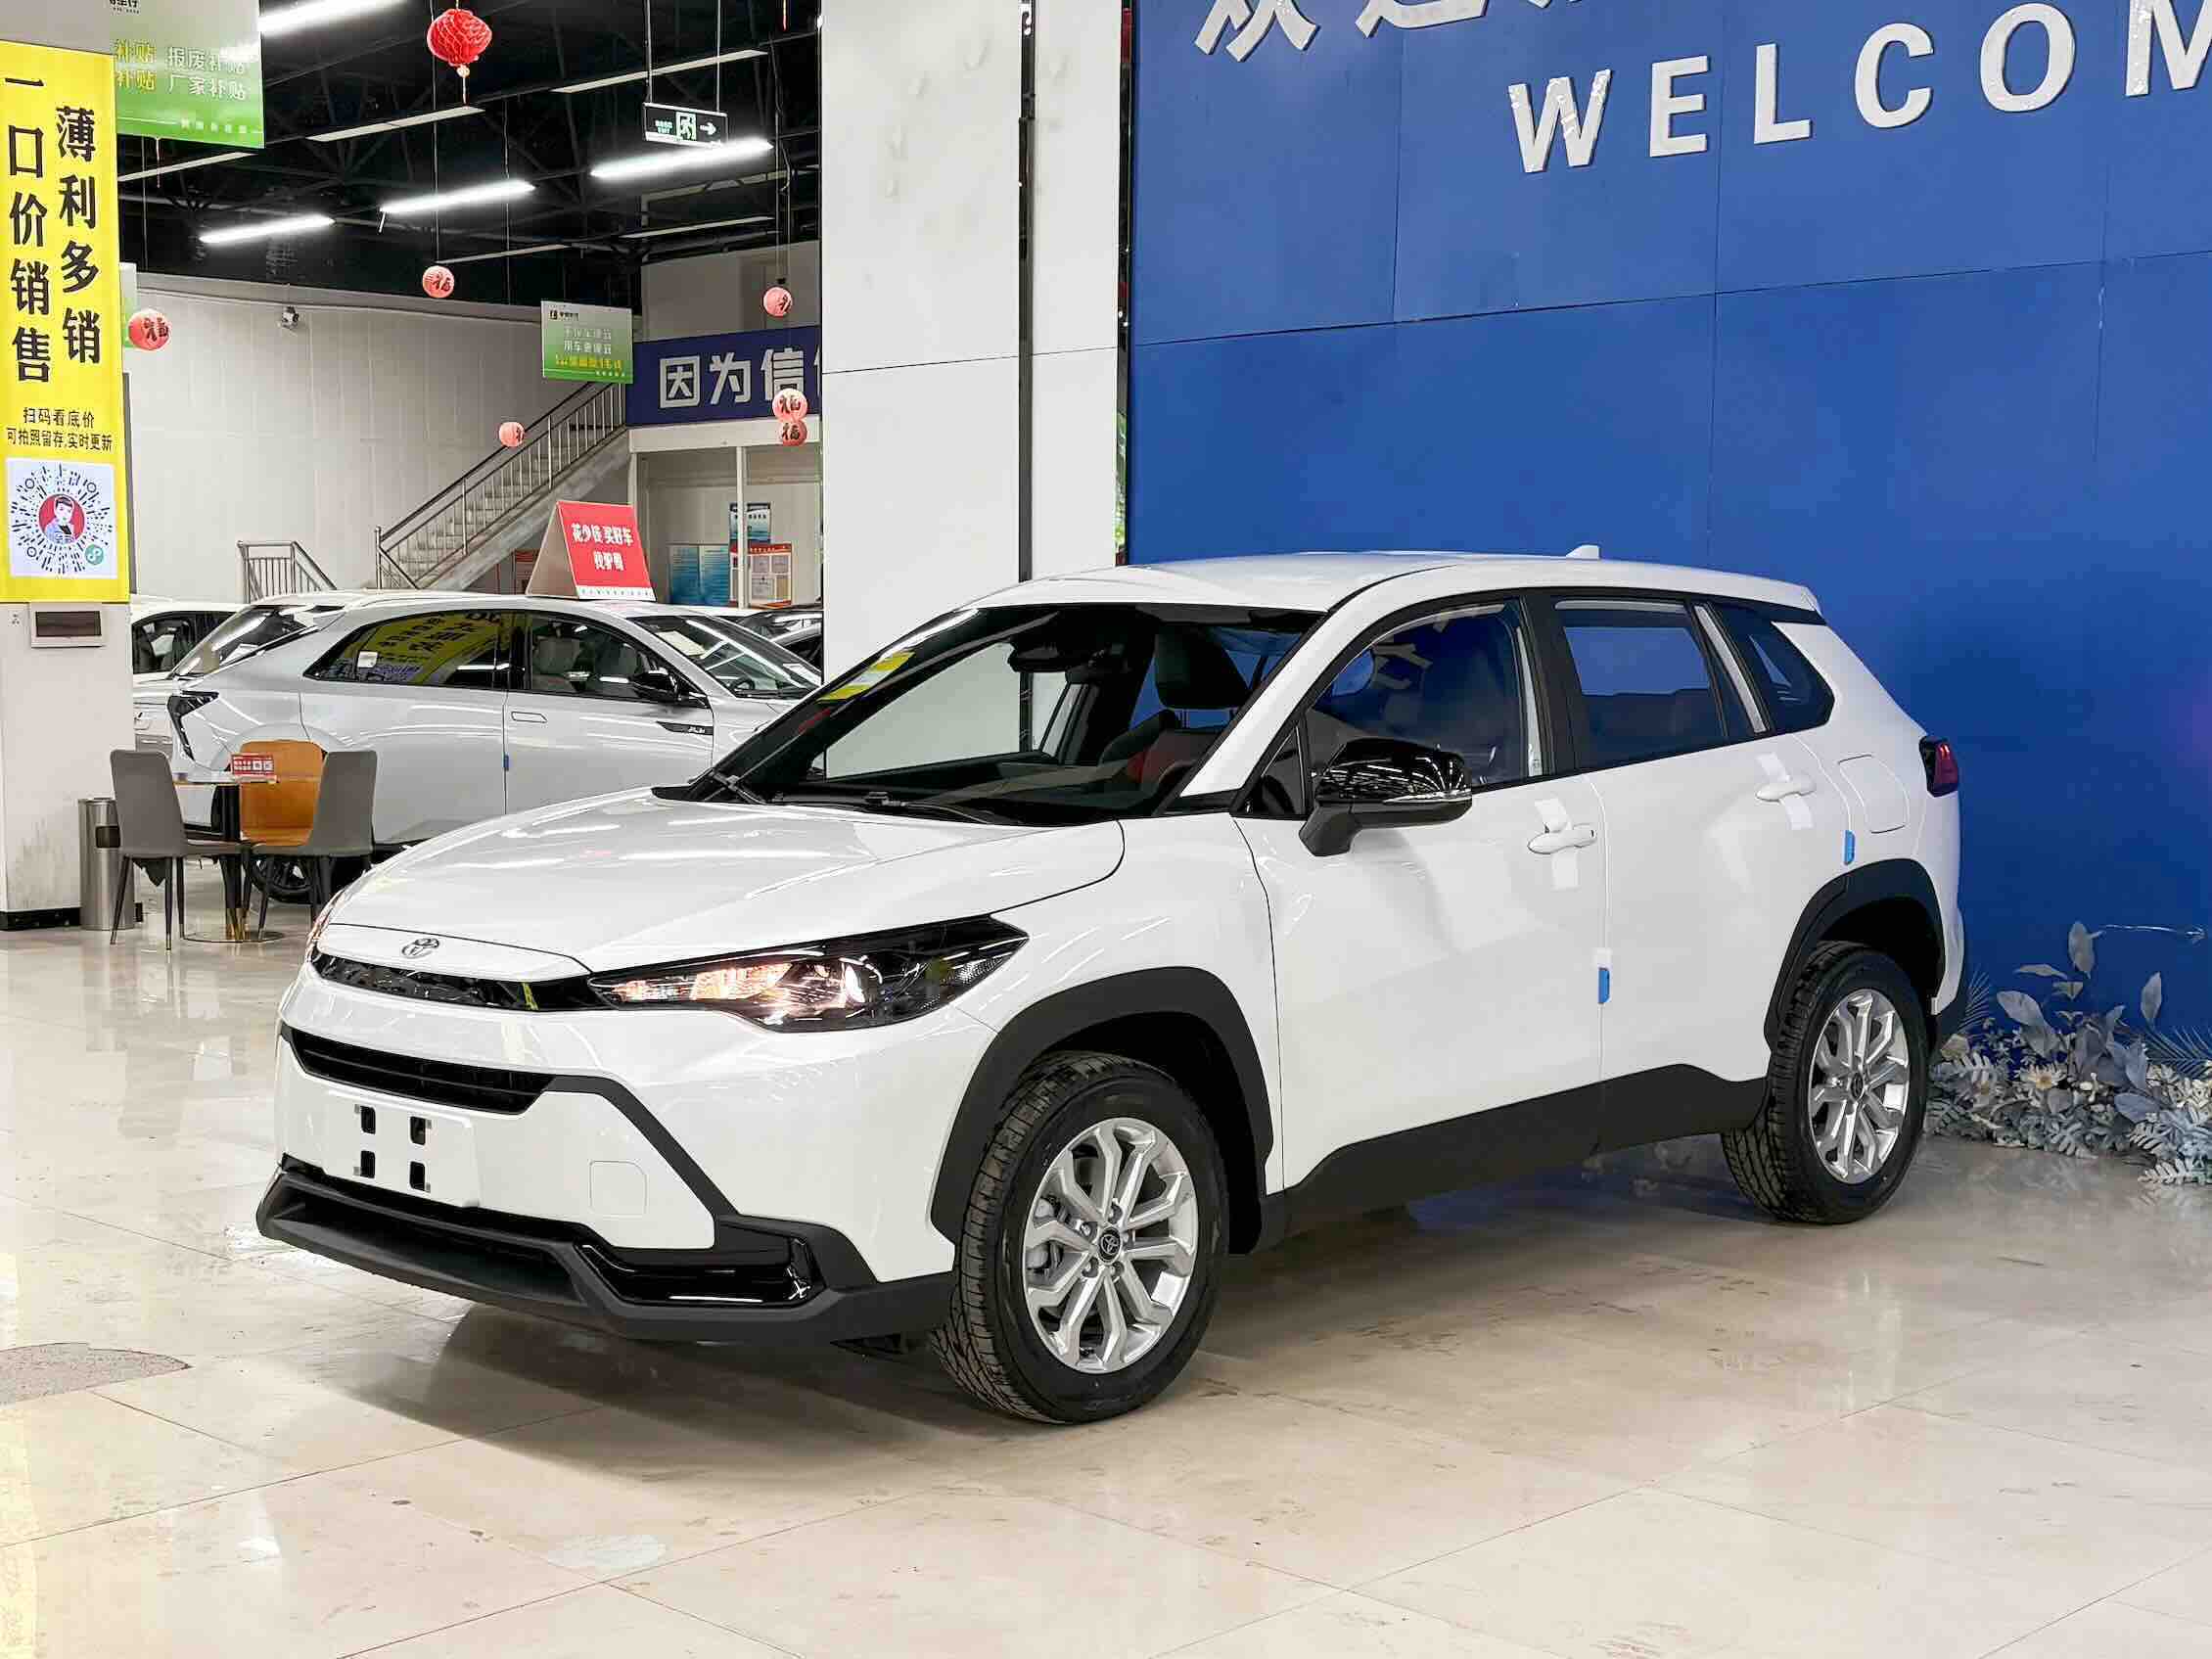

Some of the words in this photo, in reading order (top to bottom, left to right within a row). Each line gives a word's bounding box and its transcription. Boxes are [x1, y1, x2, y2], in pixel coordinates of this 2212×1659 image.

[5, 77, 50, 383] 一口价销售
[56, 106, 101, 364] 薄利多销
[23, 406, 95, 429] 扫码看底价
[660, 345, 820, 408] 因为信
